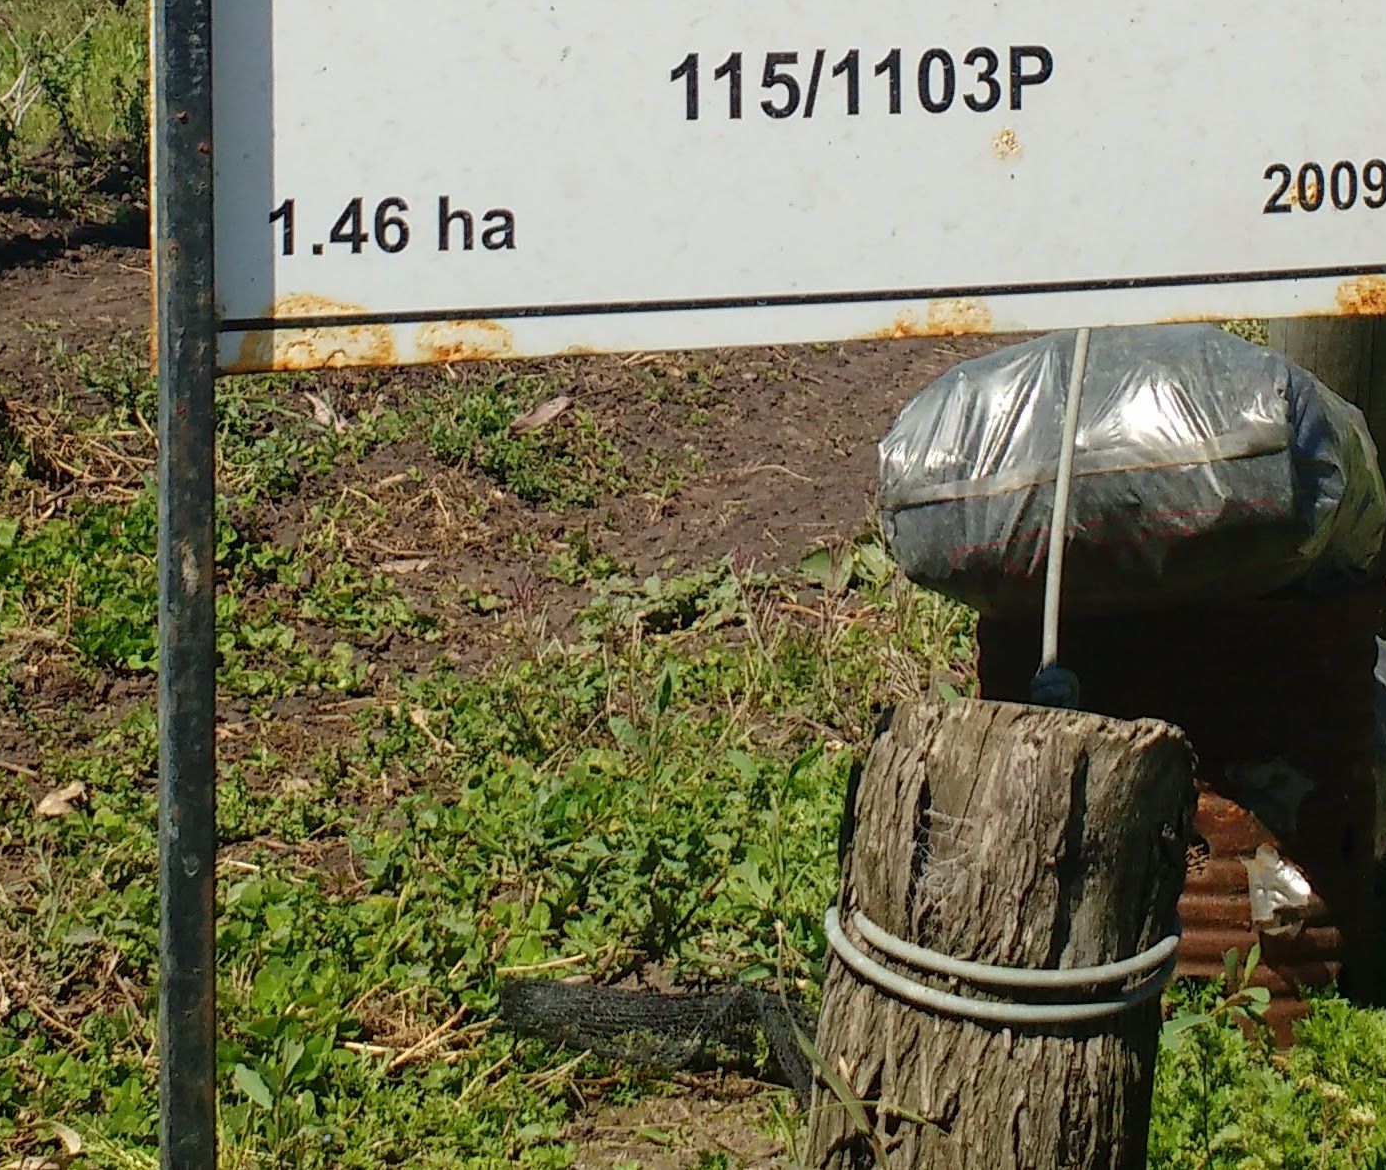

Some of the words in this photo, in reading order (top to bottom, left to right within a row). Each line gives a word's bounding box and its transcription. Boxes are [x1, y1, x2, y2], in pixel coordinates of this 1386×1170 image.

[670, 45, 1054, 121] 115/1103P
[267, 197, 410, 256] 1.46
[438, 195, 516, 252] ha
